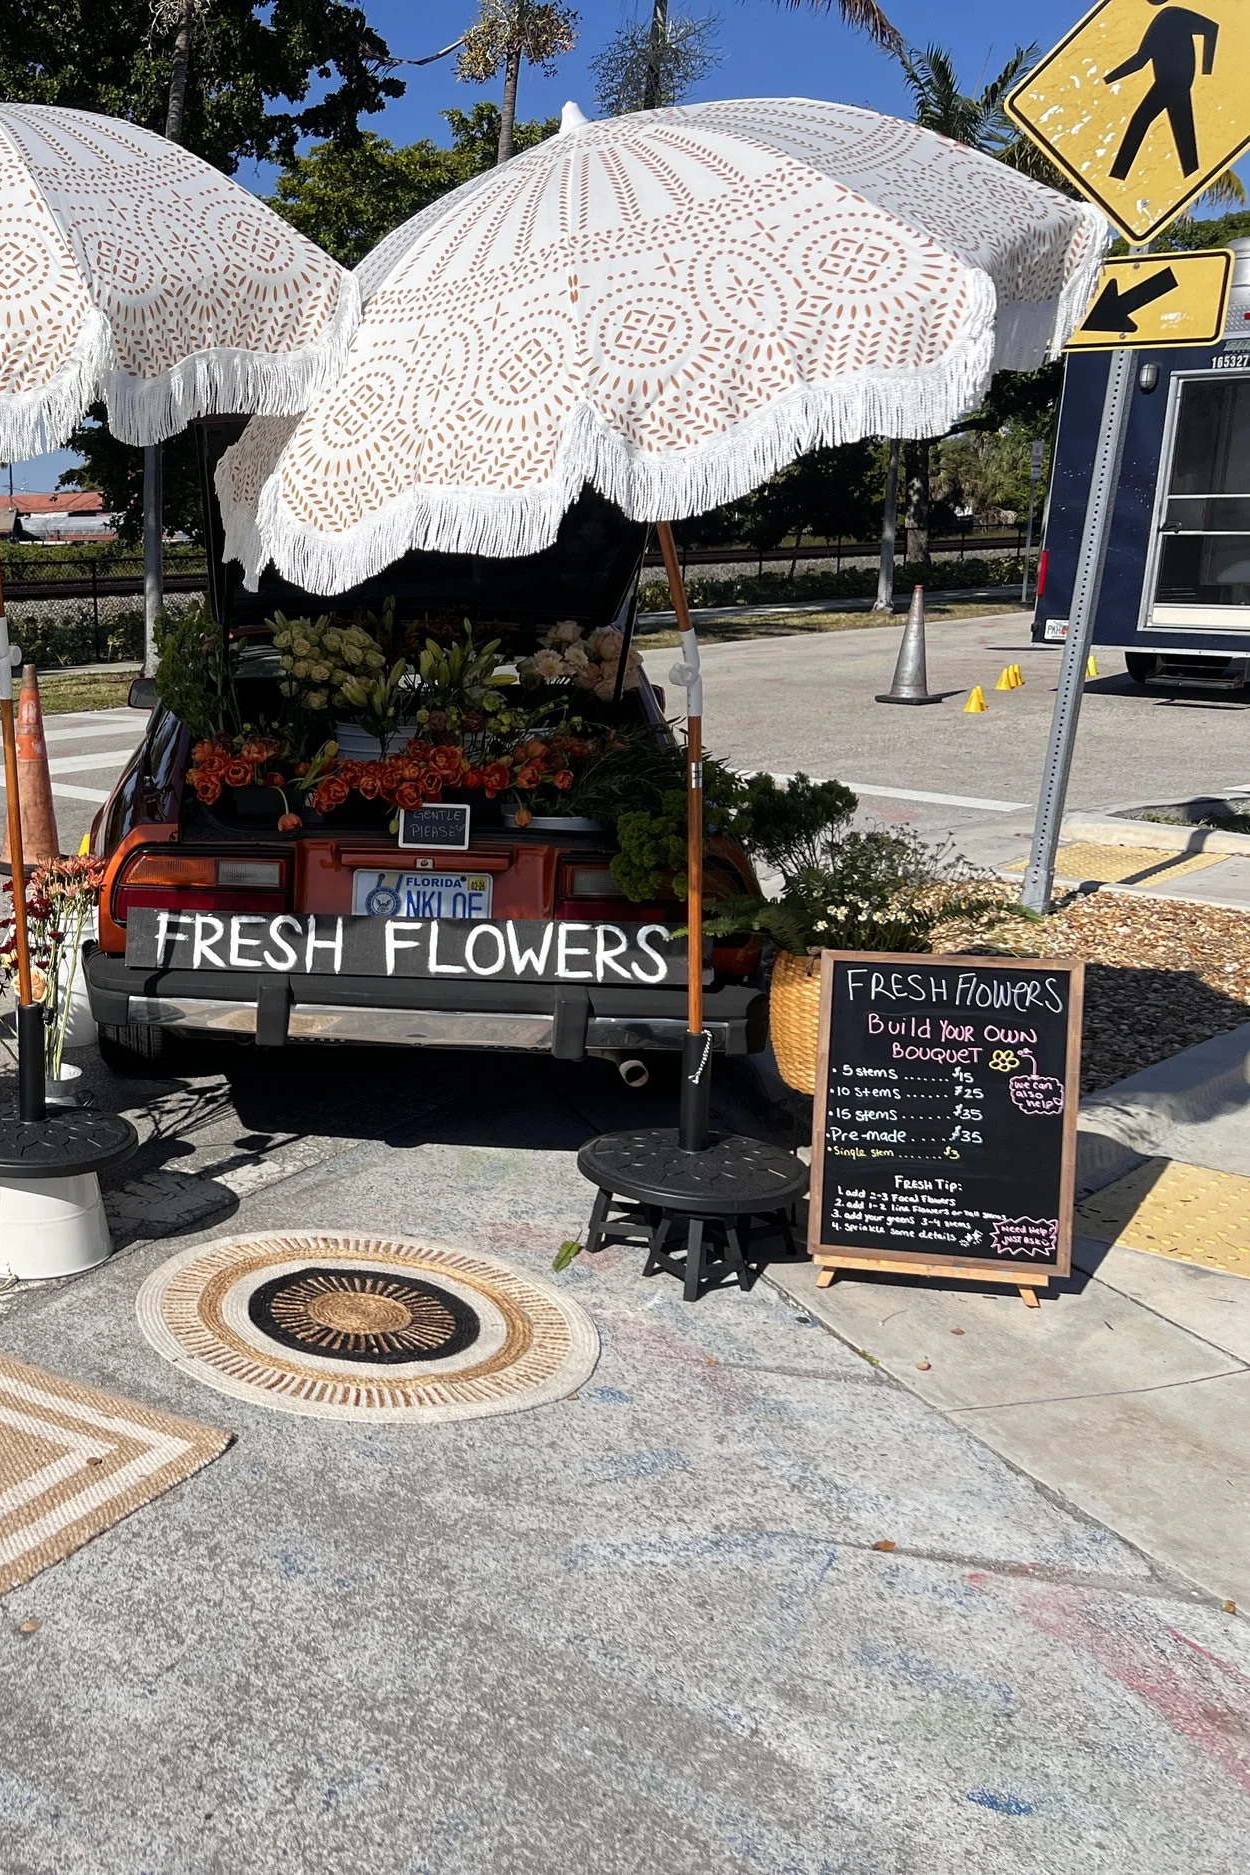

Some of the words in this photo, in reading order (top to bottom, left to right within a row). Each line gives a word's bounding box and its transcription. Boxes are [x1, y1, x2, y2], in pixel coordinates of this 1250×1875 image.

[1212, 354, 1249, 369] 165327
[406, 877, 462, 888] FLORIDA
[155, 912, 343, 974] FRESH
[384, 919, 671, 983] FLOWERS
[847, 969, 948, 1002] FRESH
[868, 1012, 931, 1039] Build
[939, 1019, 975, 1042] YOUR
[983, 1025, 1038, 1043] OWN
[842, 1064, 853, 1076] 5
[856, 1067, 899, 1080] stems
[952, 1066, 974, 1083] $15
[837, 1086, 851, 1096] 10
[954, 1085, 985, 1099] $25
[1033, 1081, 1053, 1090] can
[1015, 1090, 1044, 1099] also
[836, 1107, 852, 1120] 15
[855, 1109, 898, 1122] stems
[953, 1104, 984, 1120] $35
[830, 1127, 907, 1143] Pre-made
[951, 1125, 983, 1144] $35
[834, 1146, 867, 1160] Single
[871, 1148, 894, 1158] stem
[943, 1146, 961, 1160] $3
[894, 1175, 933, 1190] FRESH
[845, 1189, 866, 1198] add
[834, 1198, 845, 1207] 2.
[846, 1200, 865, 1209] add
[831, 1209, 842, 1218] 3.
[844, 1211, 863, 1220] add
[864, 1213, 885, 1223] your
[921, 1217, 941, 1227] 3-4
[831, 1221, 842, 1231] 4.
[890, 1228, 915, 1238] some
[918, 1229, 957, 1242] details
